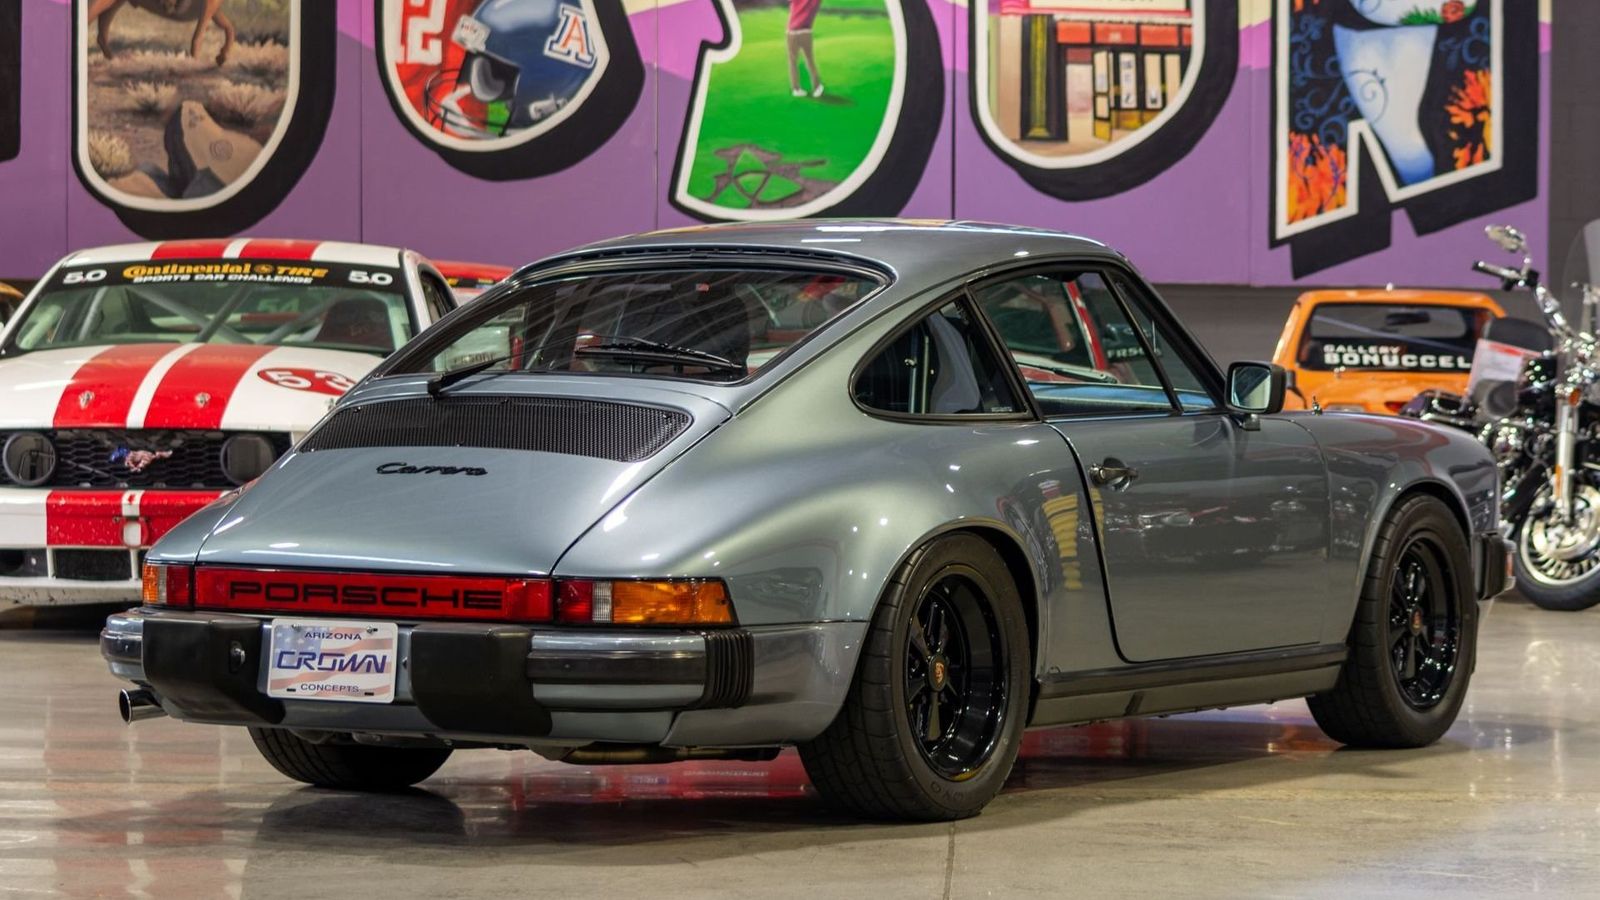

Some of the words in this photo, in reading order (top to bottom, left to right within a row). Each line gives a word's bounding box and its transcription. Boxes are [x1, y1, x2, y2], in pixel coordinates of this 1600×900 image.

[63, 269, 107, 284] 5.0
[122, 263, 251, 279] Continental
[276, 266, 329, 278] TIRE
[133, 274, 191, 283] SPORTS
[194, 273, 224, 281] CAR
[227, 274, 313, 284] CHALLENGE
[348, 270, 393, 285] 5.0
[1323, 344, 1401, 354] GALLERY
[265, 370, 356, 392] 53
[376, 462, 488, 476] Carrera
[229, 581, 503, 610] PORSCHE
[304, 631, 362, 640] ARIZONA
[277, 651, 387, 673] CROWN
[300, 683, 360, 693] CONCEPTS
